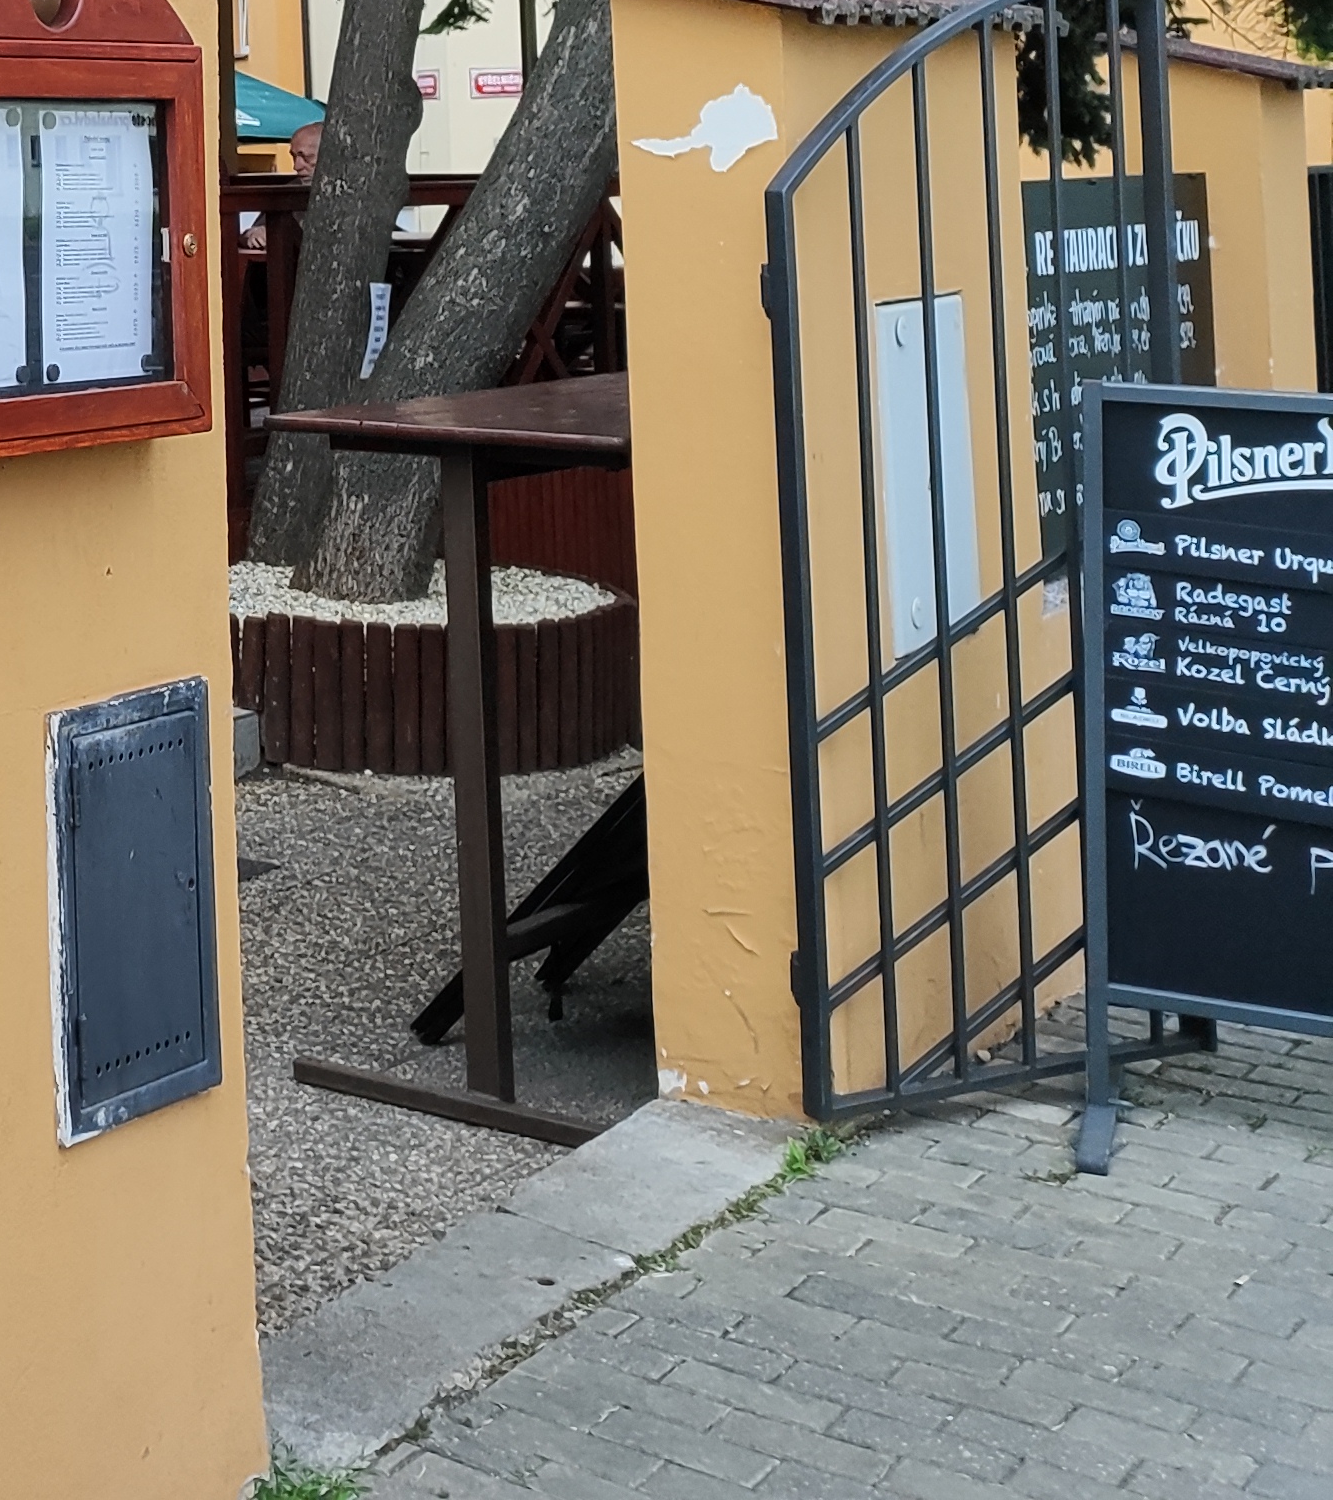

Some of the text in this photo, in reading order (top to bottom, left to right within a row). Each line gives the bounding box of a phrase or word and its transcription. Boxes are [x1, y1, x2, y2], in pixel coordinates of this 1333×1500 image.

[1175, 535, 1264, 566] Pilsner
[1275, 547, 1333, 584] Urqu
[1174, 606, 1287, 632] Rázná 10
[1176, 582, 1292, 617] Radegast
[1177, 635, 1325, 678] Velkopopovický
[1176, 656, 1331, 706] Kozel Černý
[1177, 702, 1333, 747] Volba Sládk
[1116, 758, 1161, 775] BIRELL
[1177, 762, 1246, 793] Birell
